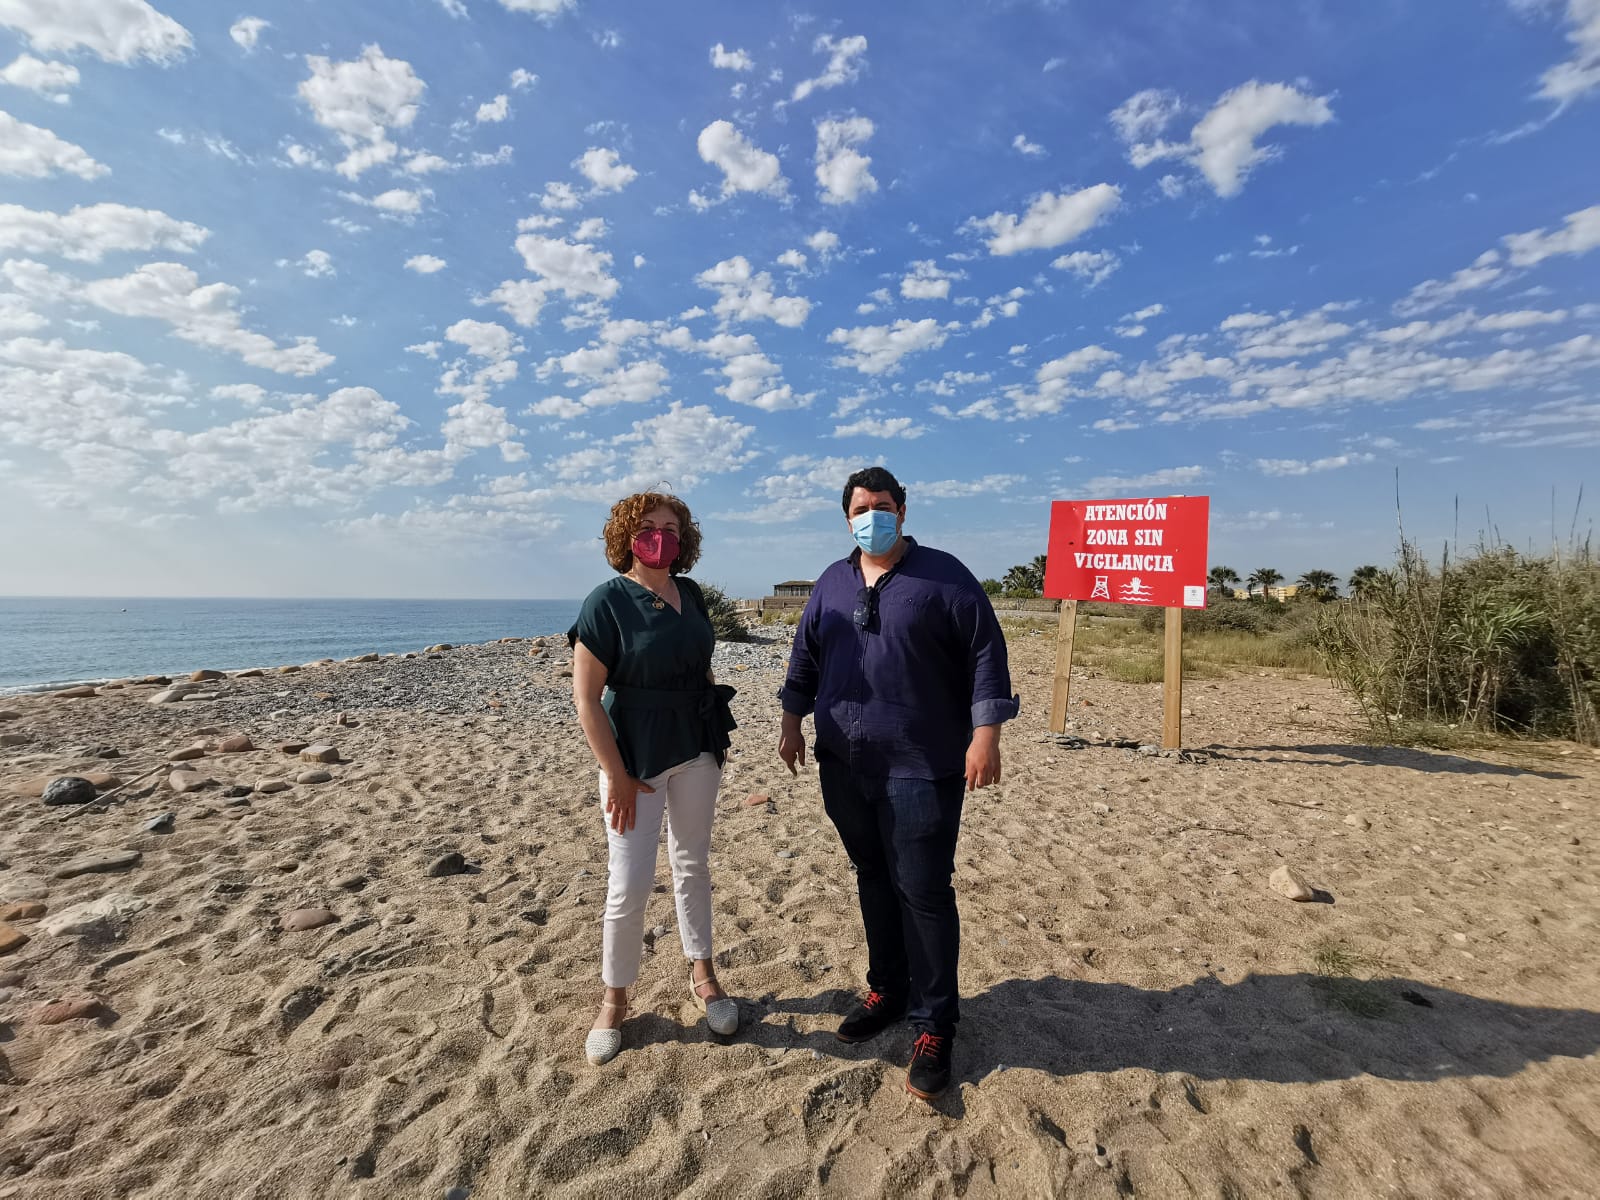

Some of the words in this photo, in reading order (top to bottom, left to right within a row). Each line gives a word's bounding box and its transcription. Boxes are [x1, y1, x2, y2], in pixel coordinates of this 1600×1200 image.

[1084, 499, 1167, 521] ATENCIÓN
[1086, 529, 1128, 545] ZONA
[1135, 529, 1163, 546] SIN
[1074, 552, 1174, 572] VIGILANCIA
